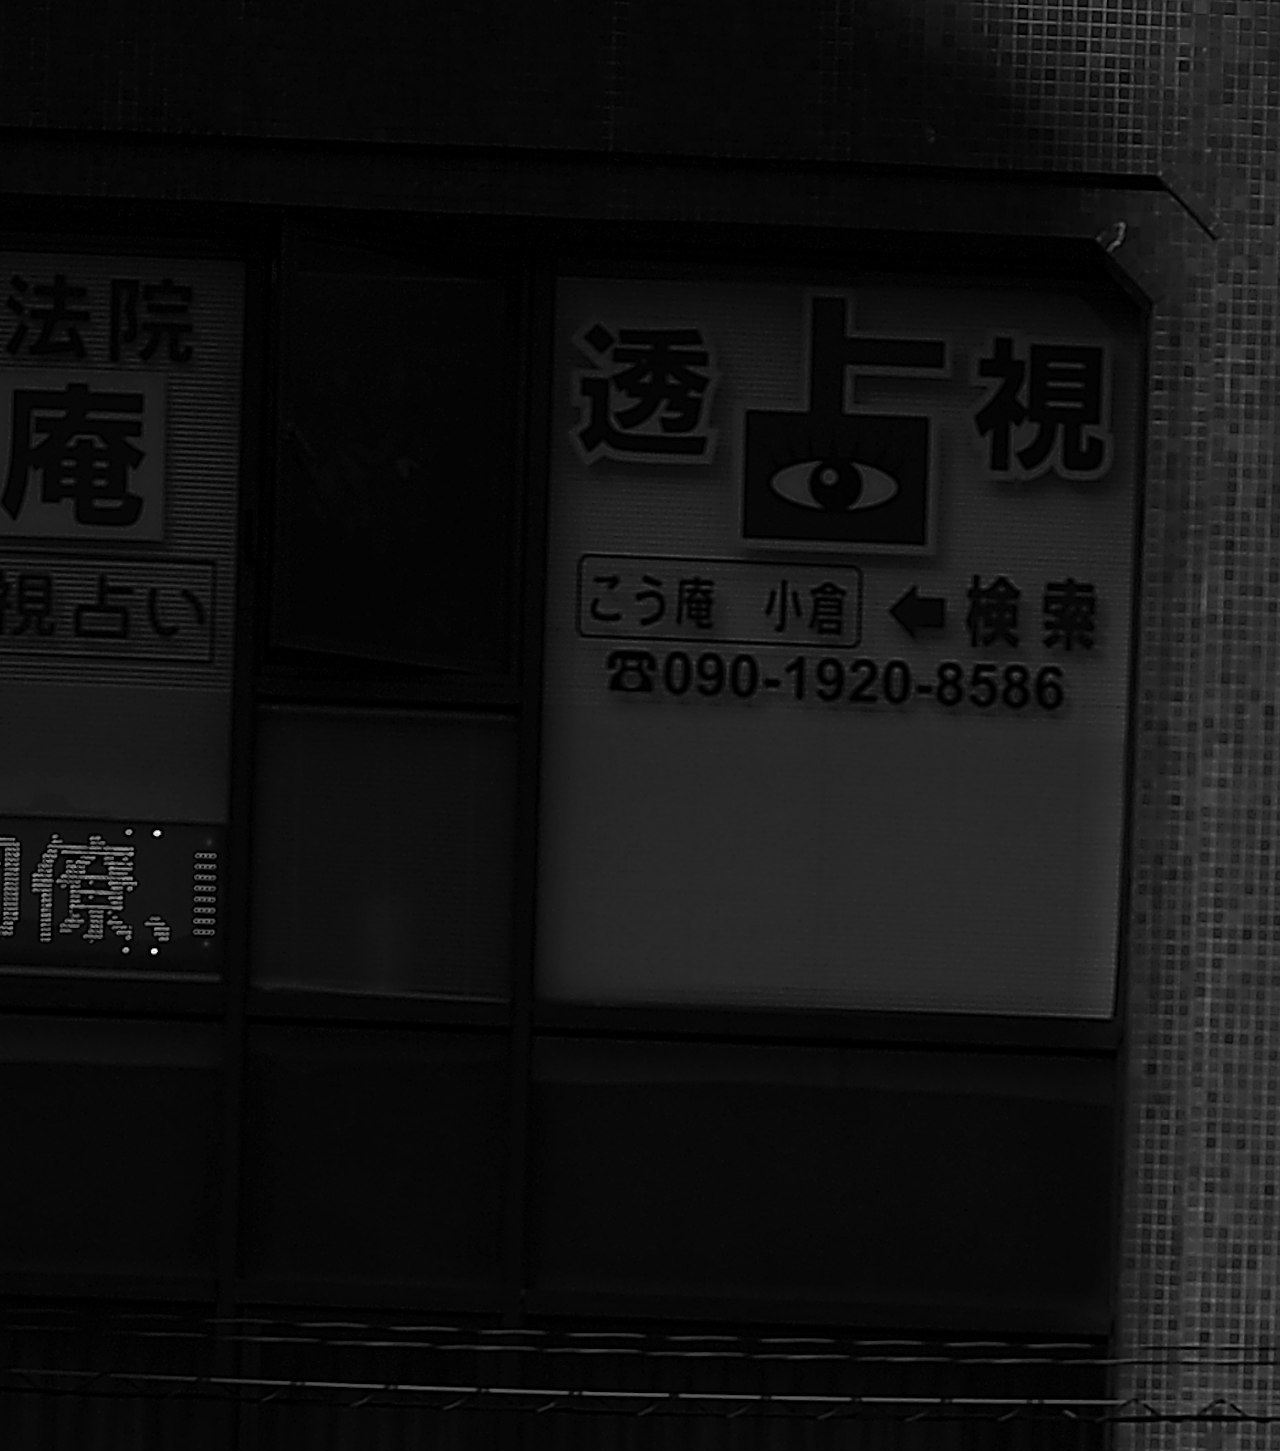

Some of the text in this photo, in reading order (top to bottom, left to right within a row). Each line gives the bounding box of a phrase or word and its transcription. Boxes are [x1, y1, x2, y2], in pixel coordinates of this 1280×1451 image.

[589, 575, 1096, 651] こう庵 小倉 検索
[665, 652, 1064, 710] 090-1920-8586
